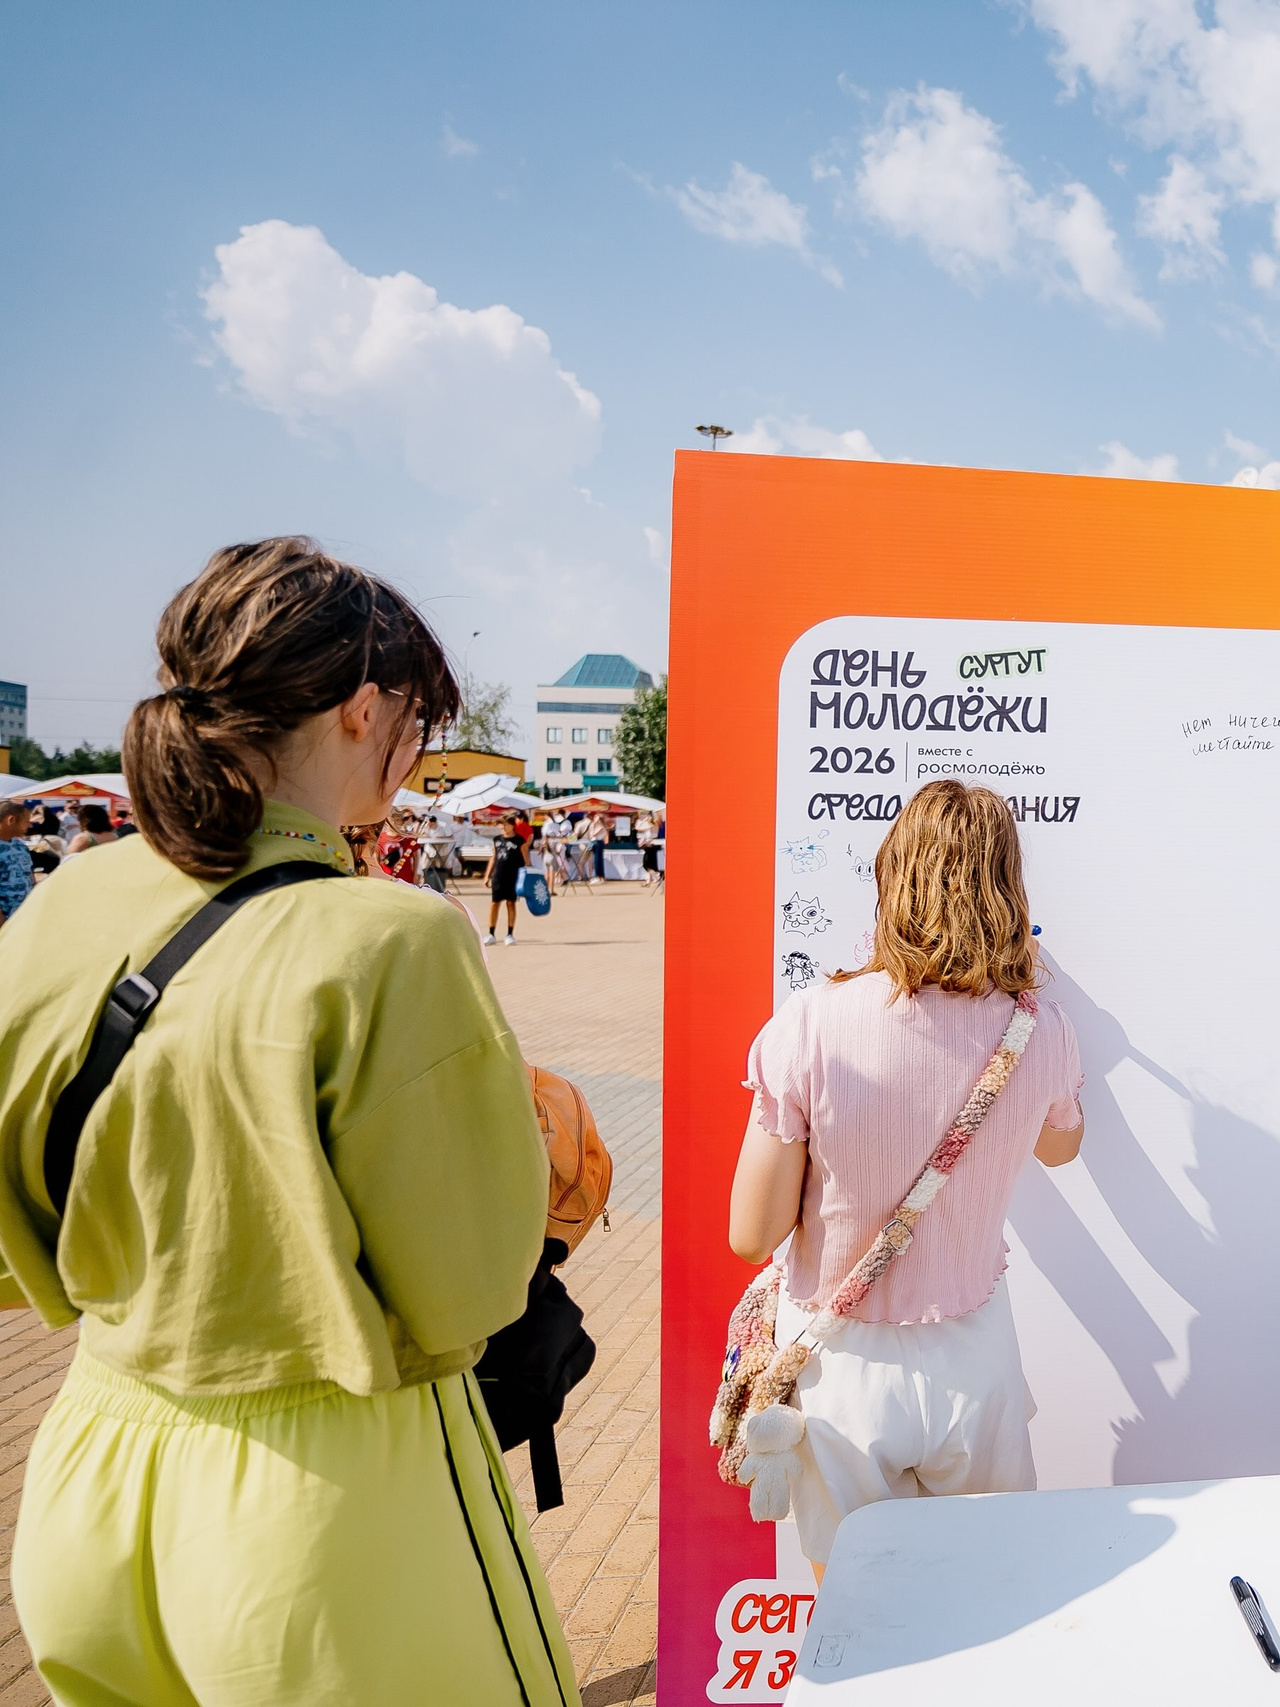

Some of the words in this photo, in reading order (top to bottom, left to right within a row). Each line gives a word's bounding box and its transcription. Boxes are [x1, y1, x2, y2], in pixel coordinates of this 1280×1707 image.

[959, 649, 1046, 679] СУРГУТ
[809, 746, 895, 774] 2026
[917, 747, 962, 757] вместе
[965, 748, 973, 757] с
[917, 761, 1046, 779] росмолодёжь
[722, 1650, 763, 1689] Я
